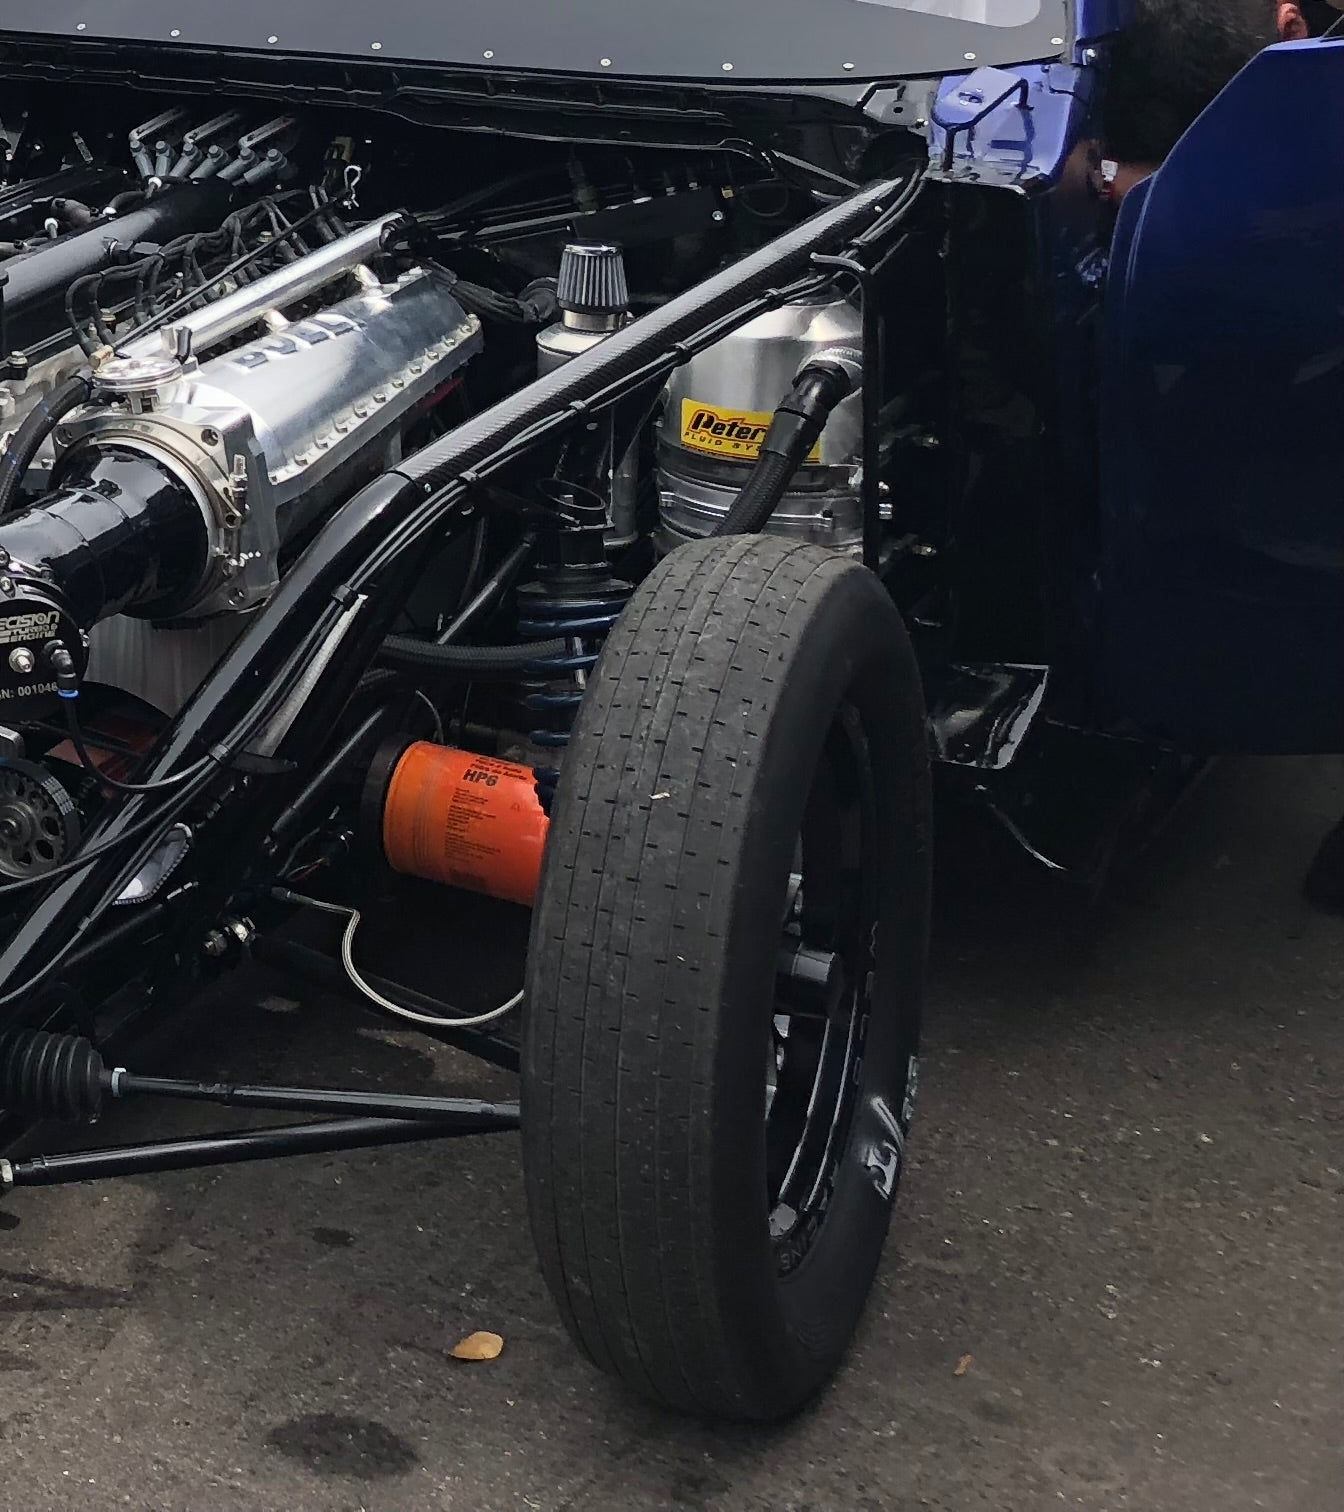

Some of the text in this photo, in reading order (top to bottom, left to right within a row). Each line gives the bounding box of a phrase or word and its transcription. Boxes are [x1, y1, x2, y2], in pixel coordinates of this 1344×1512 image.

[691, 412, 767, 441] Peter
[684, 431, 723, 446] FLUID
[462, 768, 499, 787] HP6
